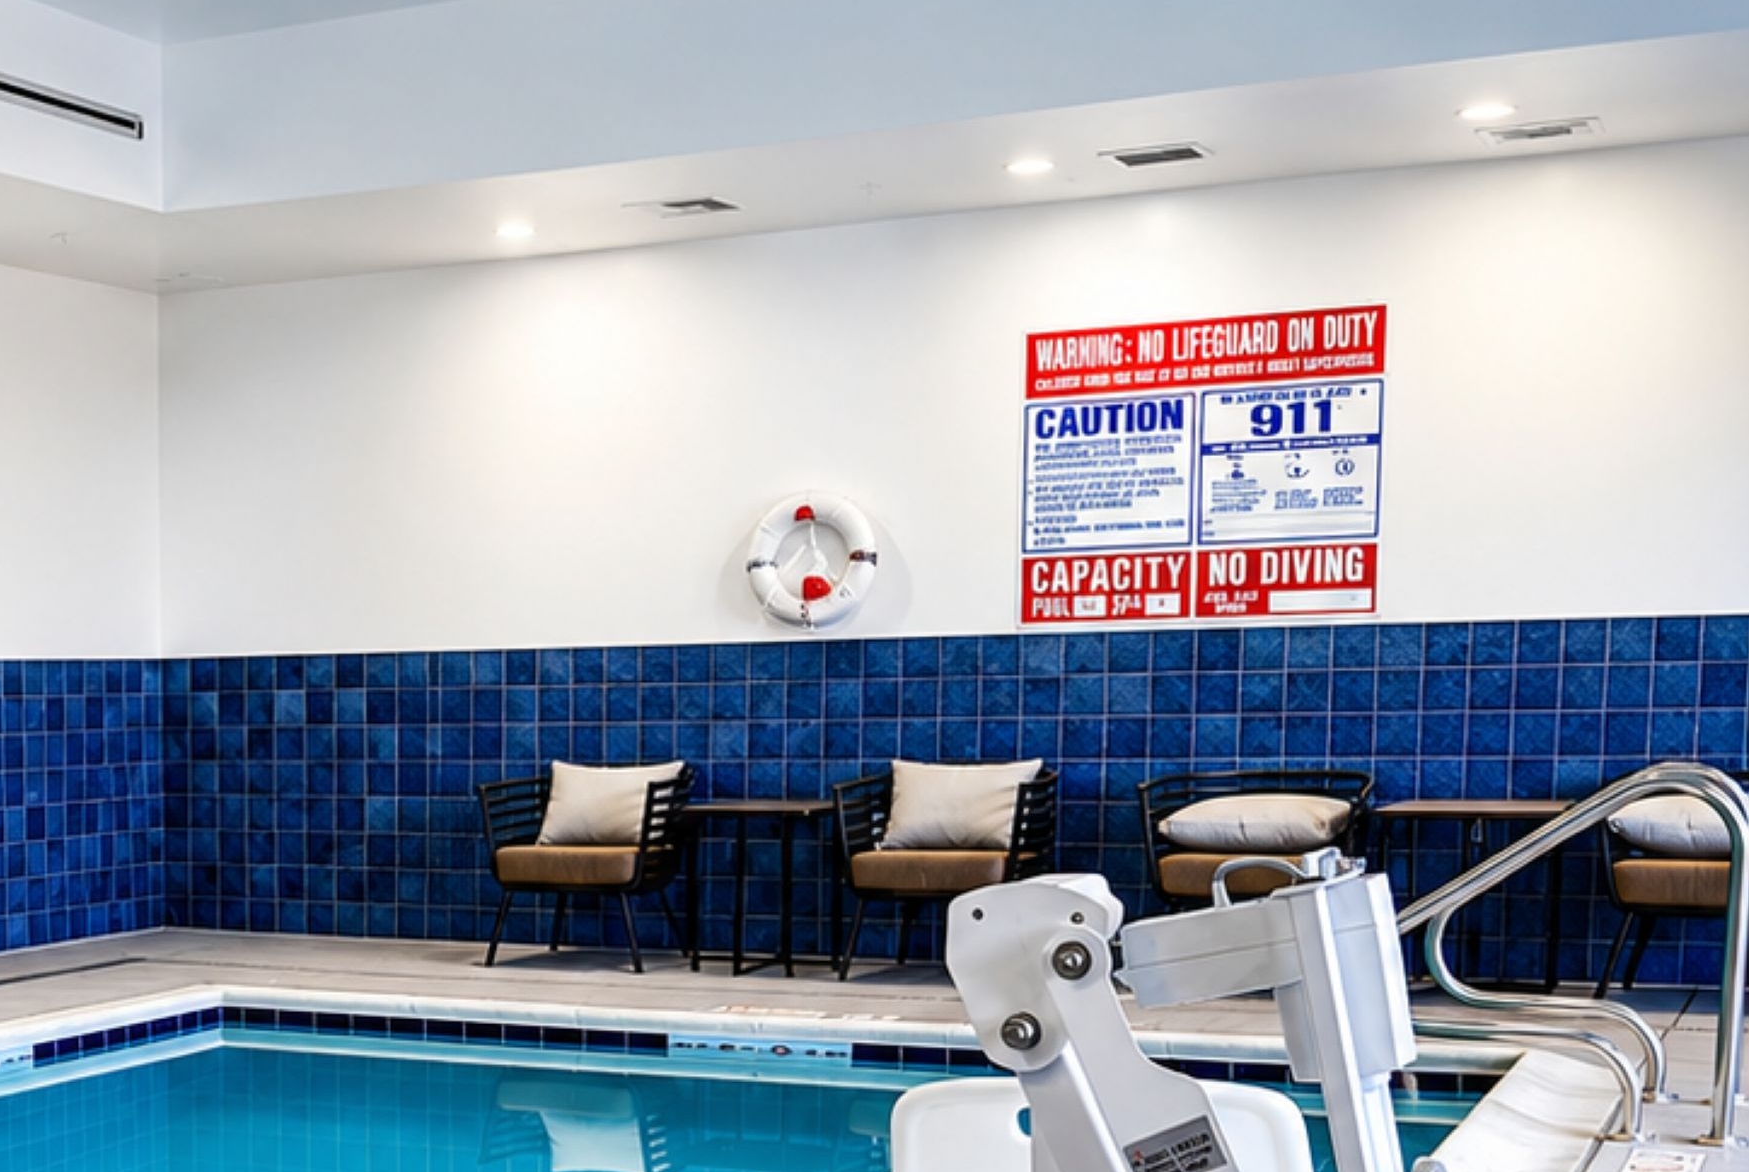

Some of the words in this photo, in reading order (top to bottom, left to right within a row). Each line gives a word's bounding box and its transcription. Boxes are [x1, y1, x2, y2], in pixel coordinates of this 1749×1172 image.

[1035, 337, 1133, 372] WARNING:
[1138, 331, 1164, 364] NO
[1172, 320, 1278, 361] LIFEGUARD
[1287, 318, 1314, 352] ON
[1323, 311, 1378, 348] DUTY
[1035, 398, 1184, 439] CAUTION
[1250, 399, 1332, 437] 911
[1031, 554, 1187, 594] CAPACITY
[1208, 551, 1248, 587] NO
[1260, 546, 1365, 585] DIVING
